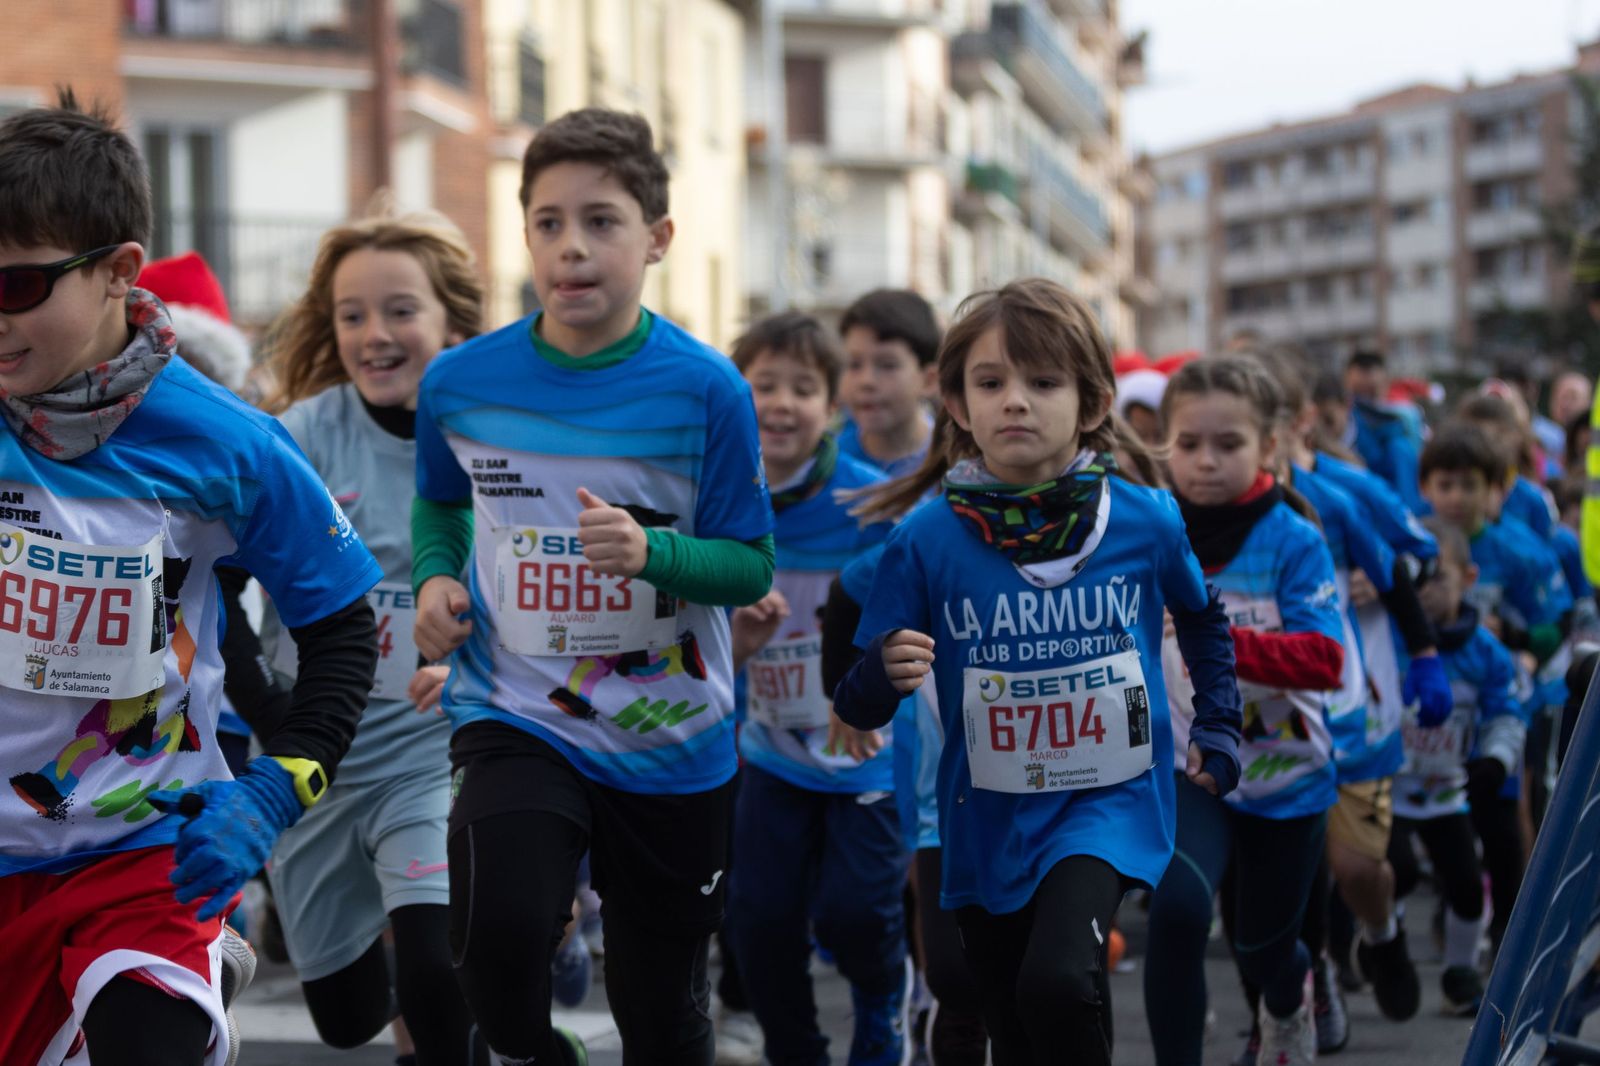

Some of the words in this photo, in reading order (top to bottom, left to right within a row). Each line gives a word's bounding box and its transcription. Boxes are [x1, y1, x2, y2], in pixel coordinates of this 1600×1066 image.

[486, 459, 508, 469] SAN
[0, 491, 24, 504] AN
[27, 543, 154, 580] SETEL
[517, 562, 632, 612] 6663
[0, 569, 132, 647] 6976
[944, 598, 982, 641] LA
[991, 575, 1141, 639] ARMUÑA
[570, 633, 620, 643] Ayuntamiento
[34, 641, 80, 657] LUCAS
[581, 643, 620, 652] Salamanca
[968, 645, 1011, 665] CLUB
[50, 669, 112, 683] Ayuntamiento
[1010, 665, 1126, 699] SETEL
[49, 682, 61, 691] de
[62, 682, 110, 694] Salamanca
[988, 697, 1107, 753] 6704
[1030, 749, 1068, 761] MARCO
[1048, 767, 1098, 780] Ayuntamiento
[1049, 780, 1058, 788] de
[1060, 776, 1099, 787] Salamanca
